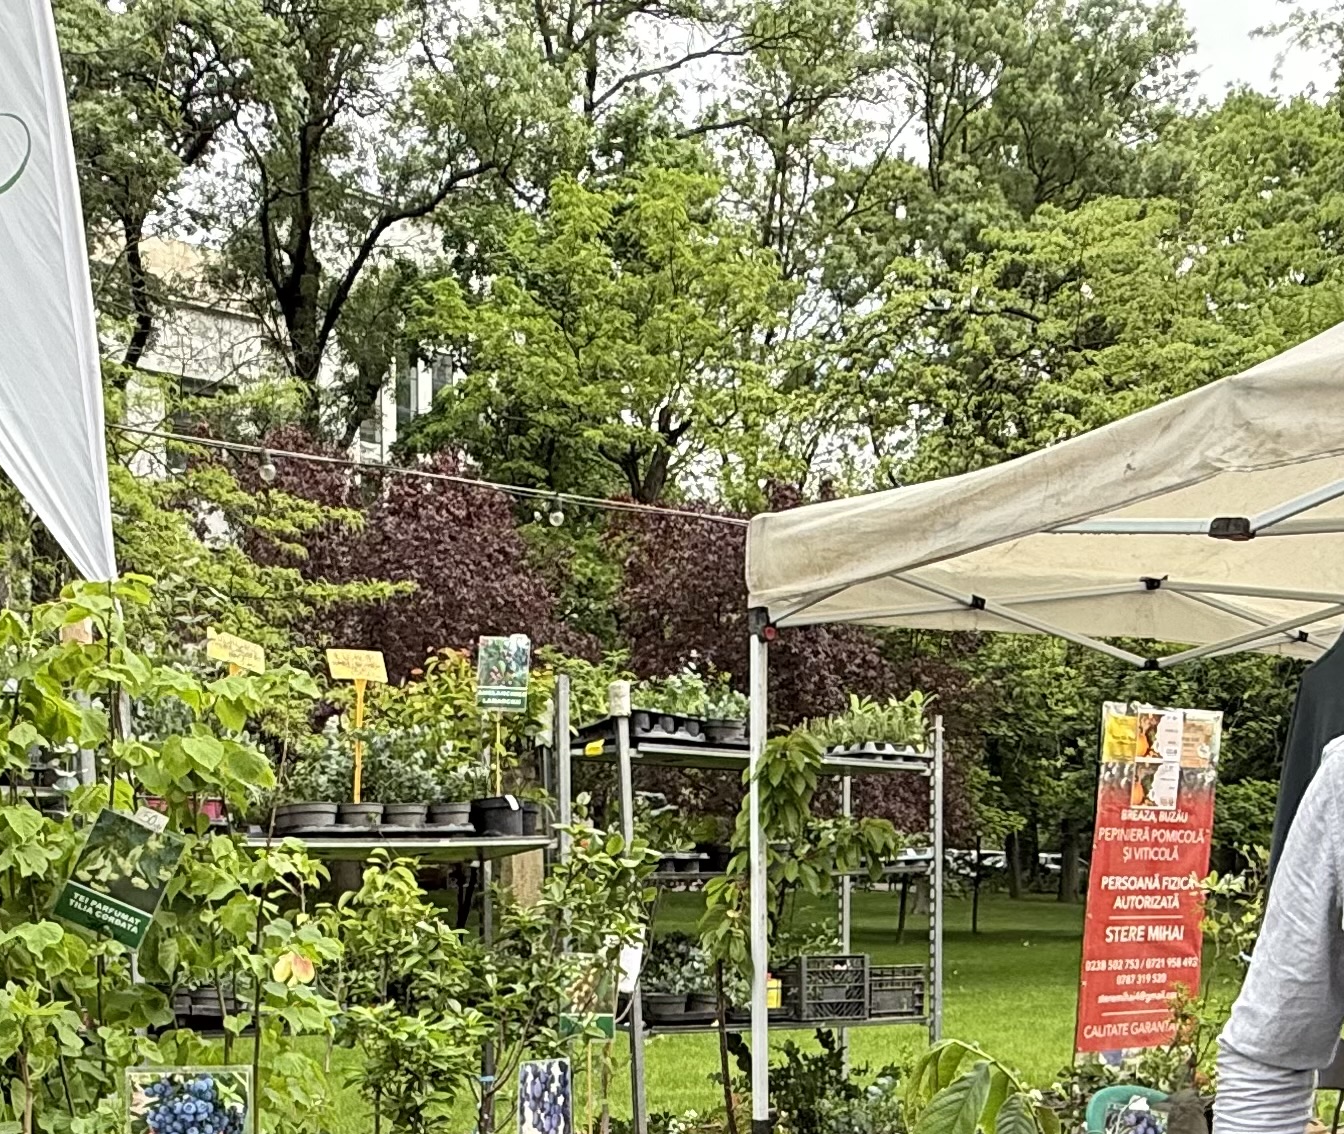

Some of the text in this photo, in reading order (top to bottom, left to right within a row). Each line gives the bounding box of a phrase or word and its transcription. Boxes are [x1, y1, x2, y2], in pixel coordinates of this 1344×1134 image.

[68, 898, 94, 916] TILIA
[73, 891, 142, 925] TEI PARFUMAT
[1104, 925, 1184, 943] STERE MIHAI
[1083, 1019, 1179, 1039] CALITATE GARANTA
